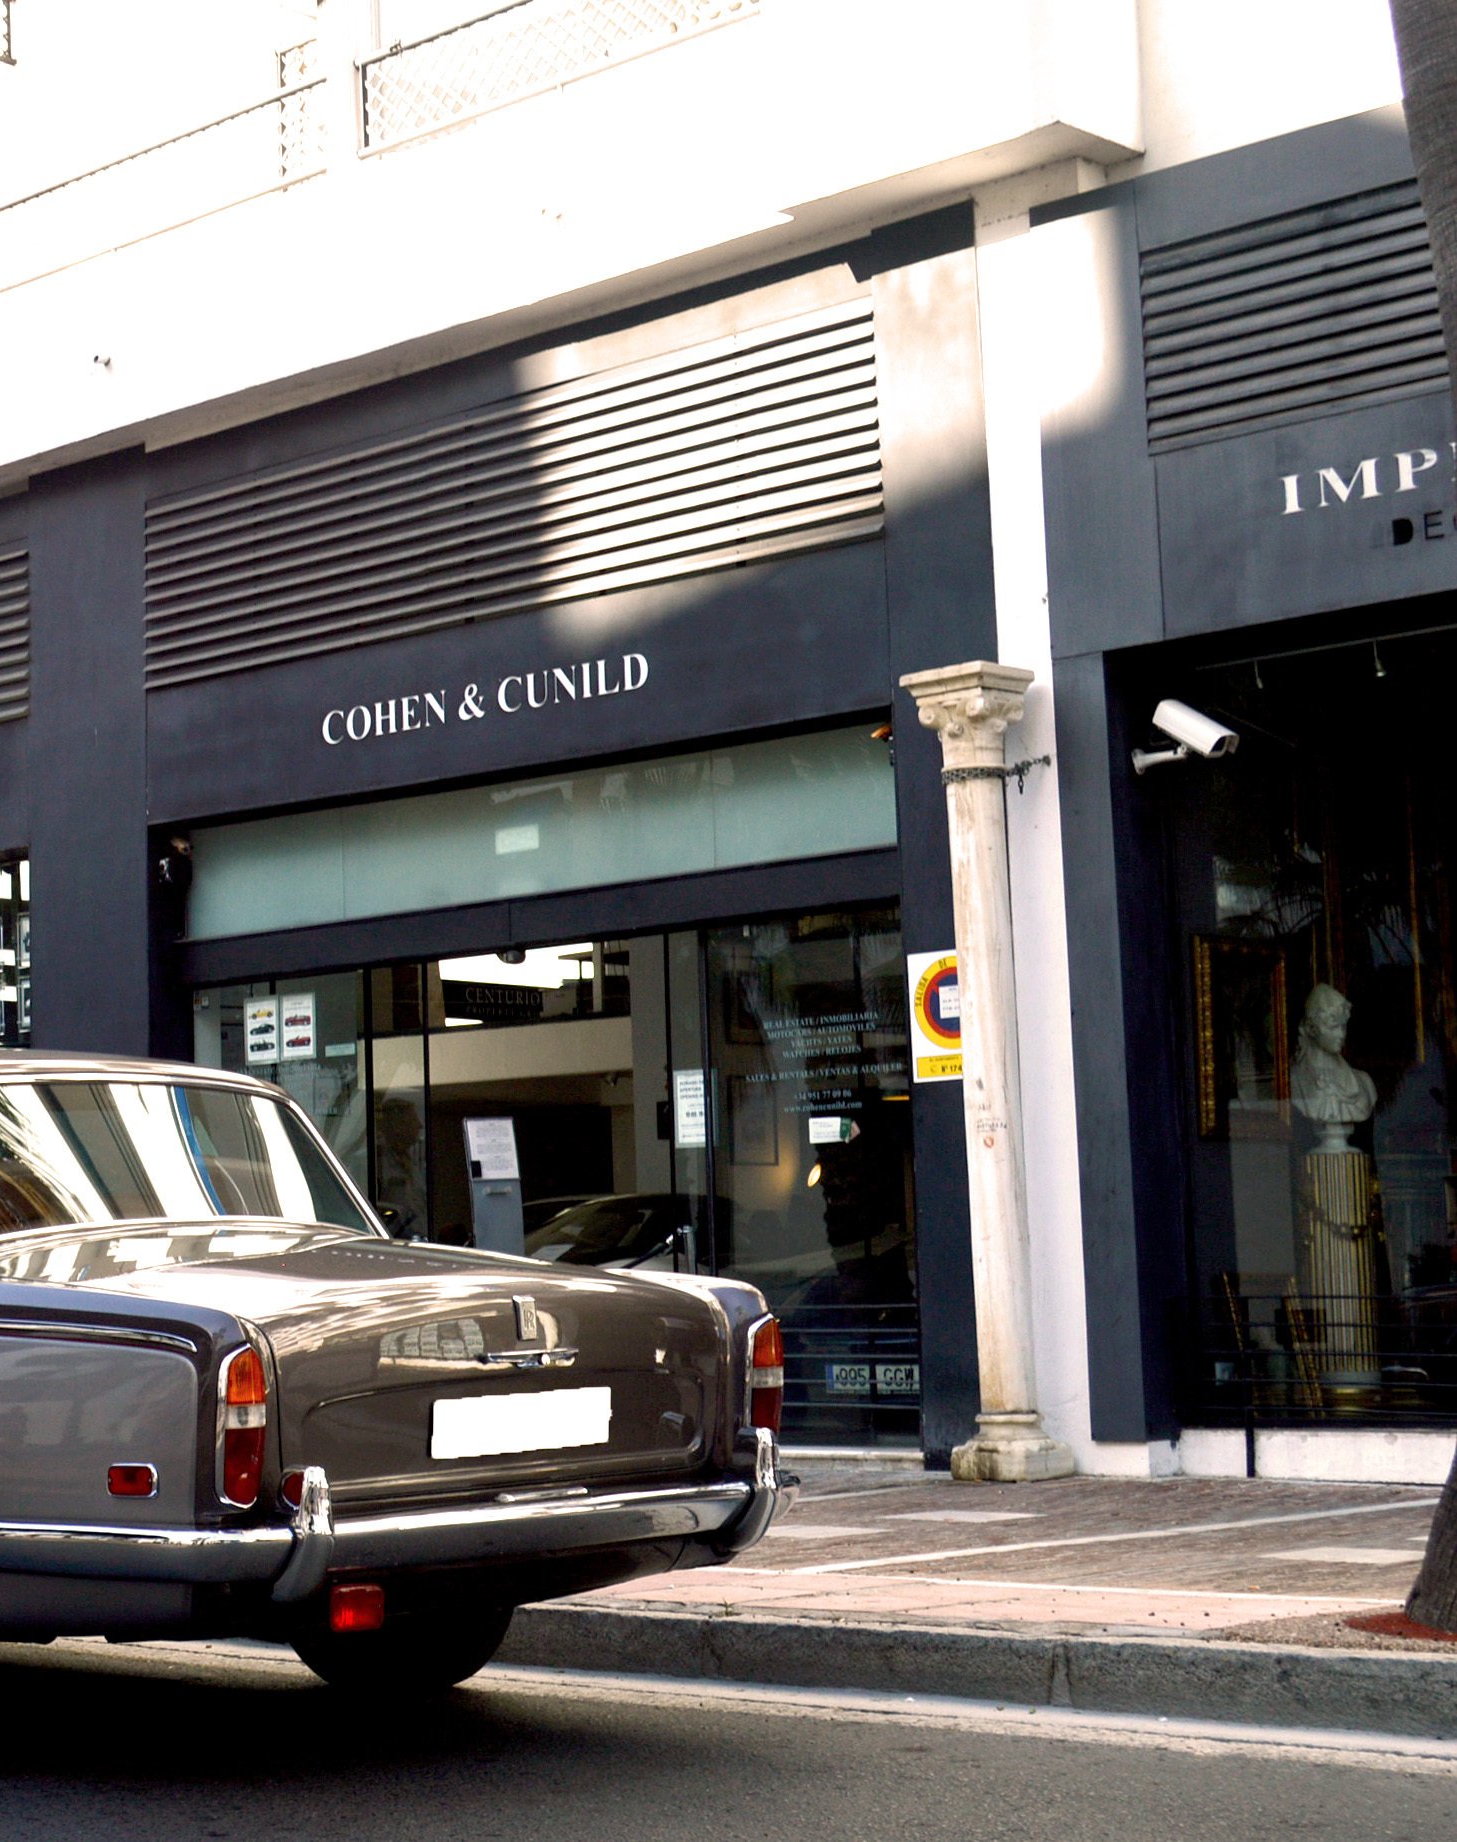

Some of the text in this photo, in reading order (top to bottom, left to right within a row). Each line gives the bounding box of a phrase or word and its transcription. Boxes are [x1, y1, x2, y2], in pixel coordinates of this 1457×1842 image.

[1280, 442, 1457, 515] IMP
[1392, 510, 1457, 546] DE
[321, 653, 649, 745] COHEN & CUNILD
[915, 977, 928, 1007] SALIDA
[763, 1019, 783, 1029] REAL
[786, 1016, 814, 1028] ESTATE
[820, 1011, 879, 1024] INMOBILIARIA
[817, 1022, 876, 1035] AUTOMOVILES
[819, 1065, 851, 1077] VENTAS
